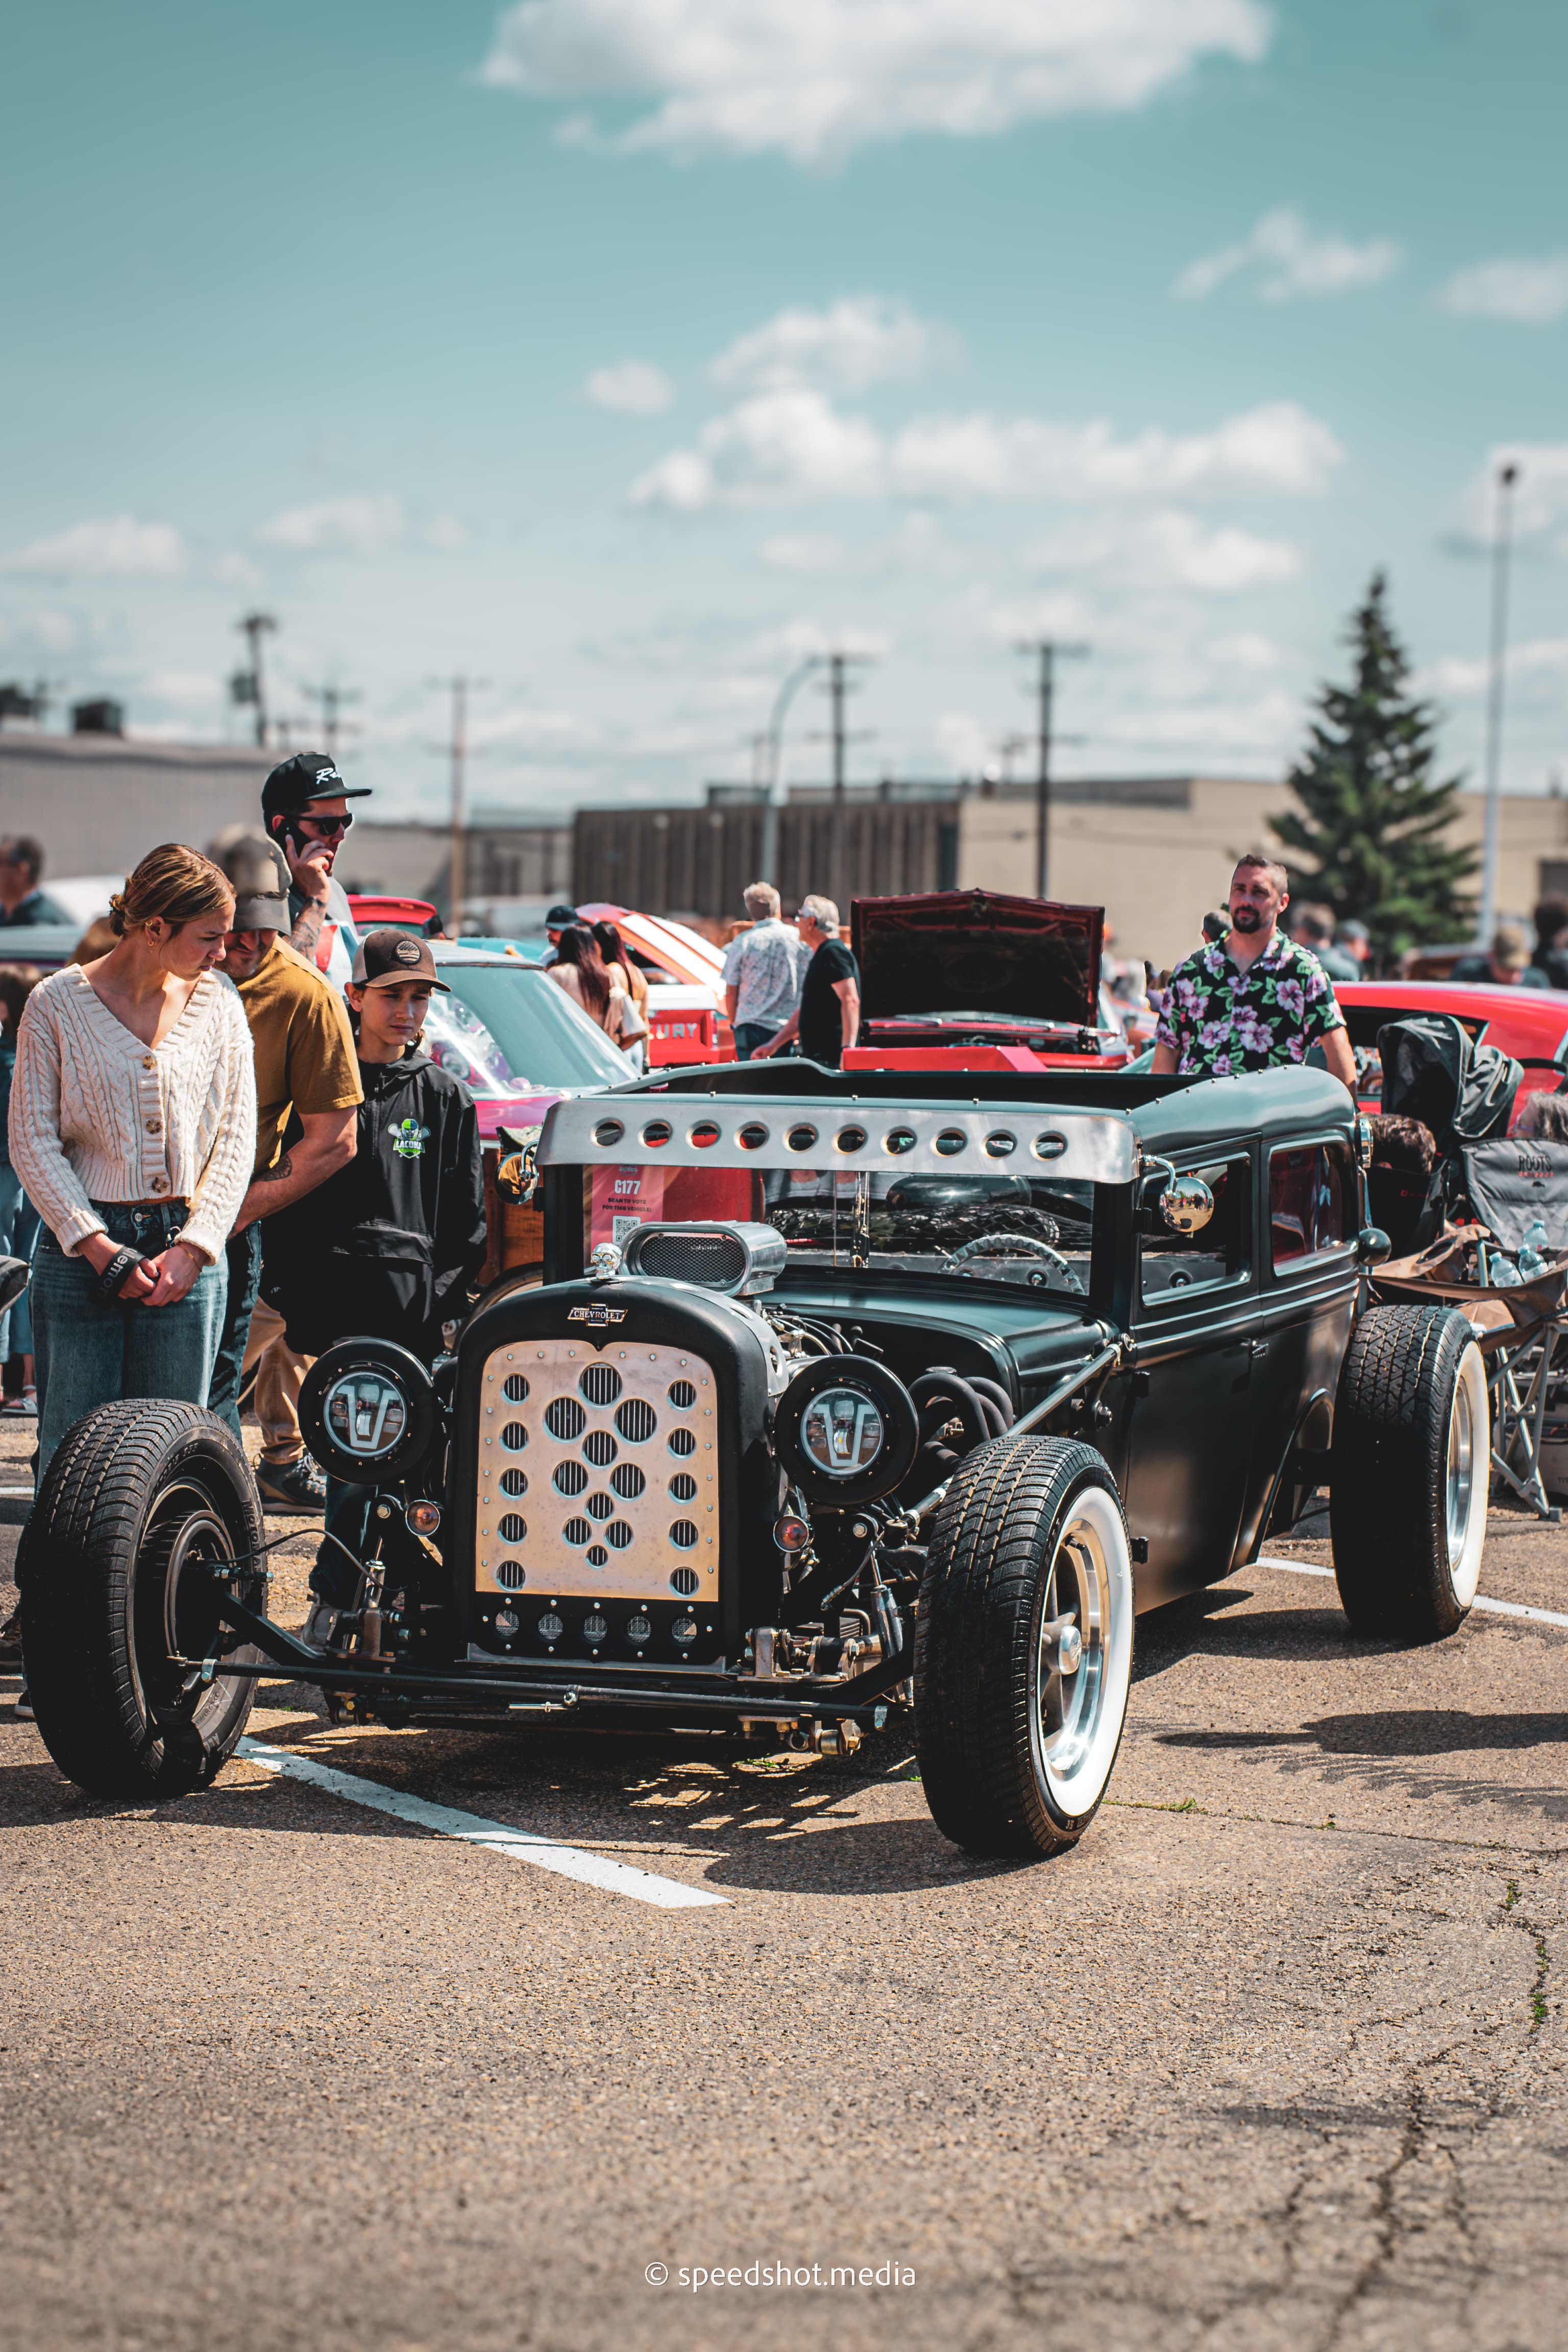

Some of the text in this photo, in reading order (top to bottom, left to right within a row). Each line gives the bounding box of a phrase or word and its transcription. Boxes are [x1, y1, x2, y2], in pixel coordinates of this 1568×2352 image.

[1518, 1155, 1552, 1171] ROOTS
[615, 1180, 641, 1194] C177
[574, 1310, 621, 1319] CHEVROLET
